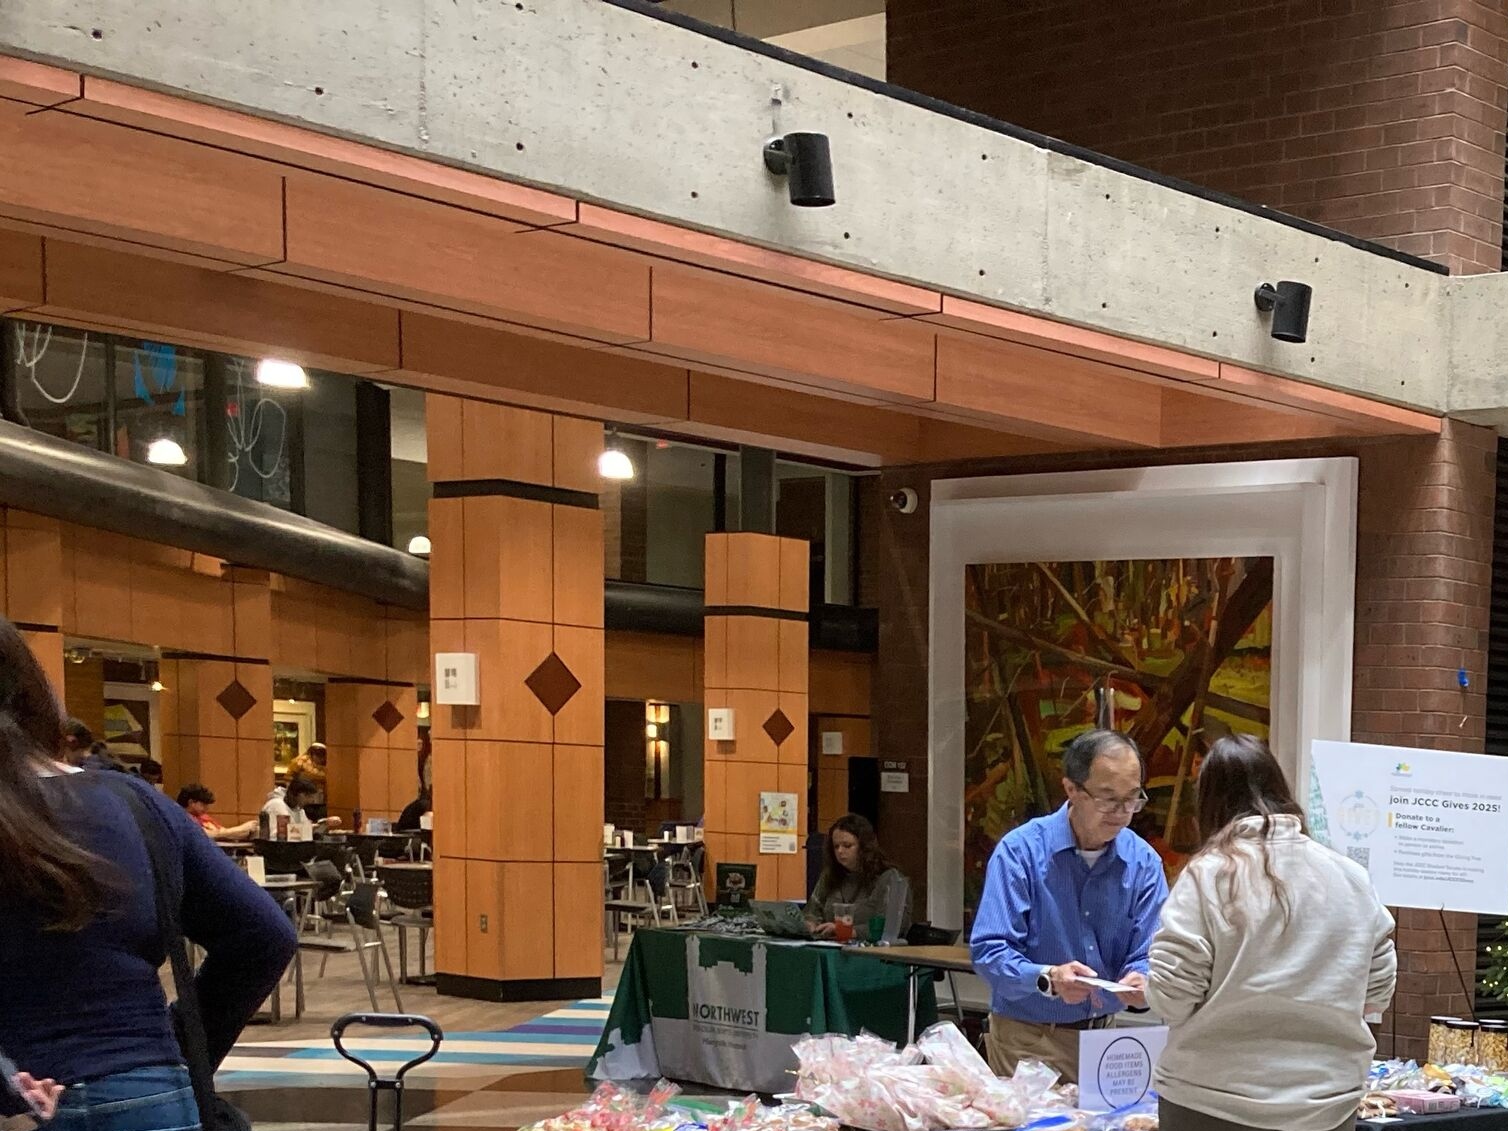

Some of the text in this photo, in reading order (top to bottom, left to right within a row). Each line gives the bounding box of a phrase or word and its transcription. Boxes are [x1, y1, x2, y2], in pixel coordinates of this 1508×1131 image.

[1412, 797, 1439, 807] JCCC
[1441, 799, 1470, 810] Gives
[1472, 802, 1501, 813] 2025!
[1395, 813, 1423, 821] Donate
[1395, 821, 1419, 830] fellow
[692, 1002, 760, 1027] NORTHWEST
[1106, 1052, 1142, 1060] HOMEMADE
[1105, 1061, 1143, 1070] FOOD ITEMS
[1106, 1069, 1142, 1078] ALLERGENS
